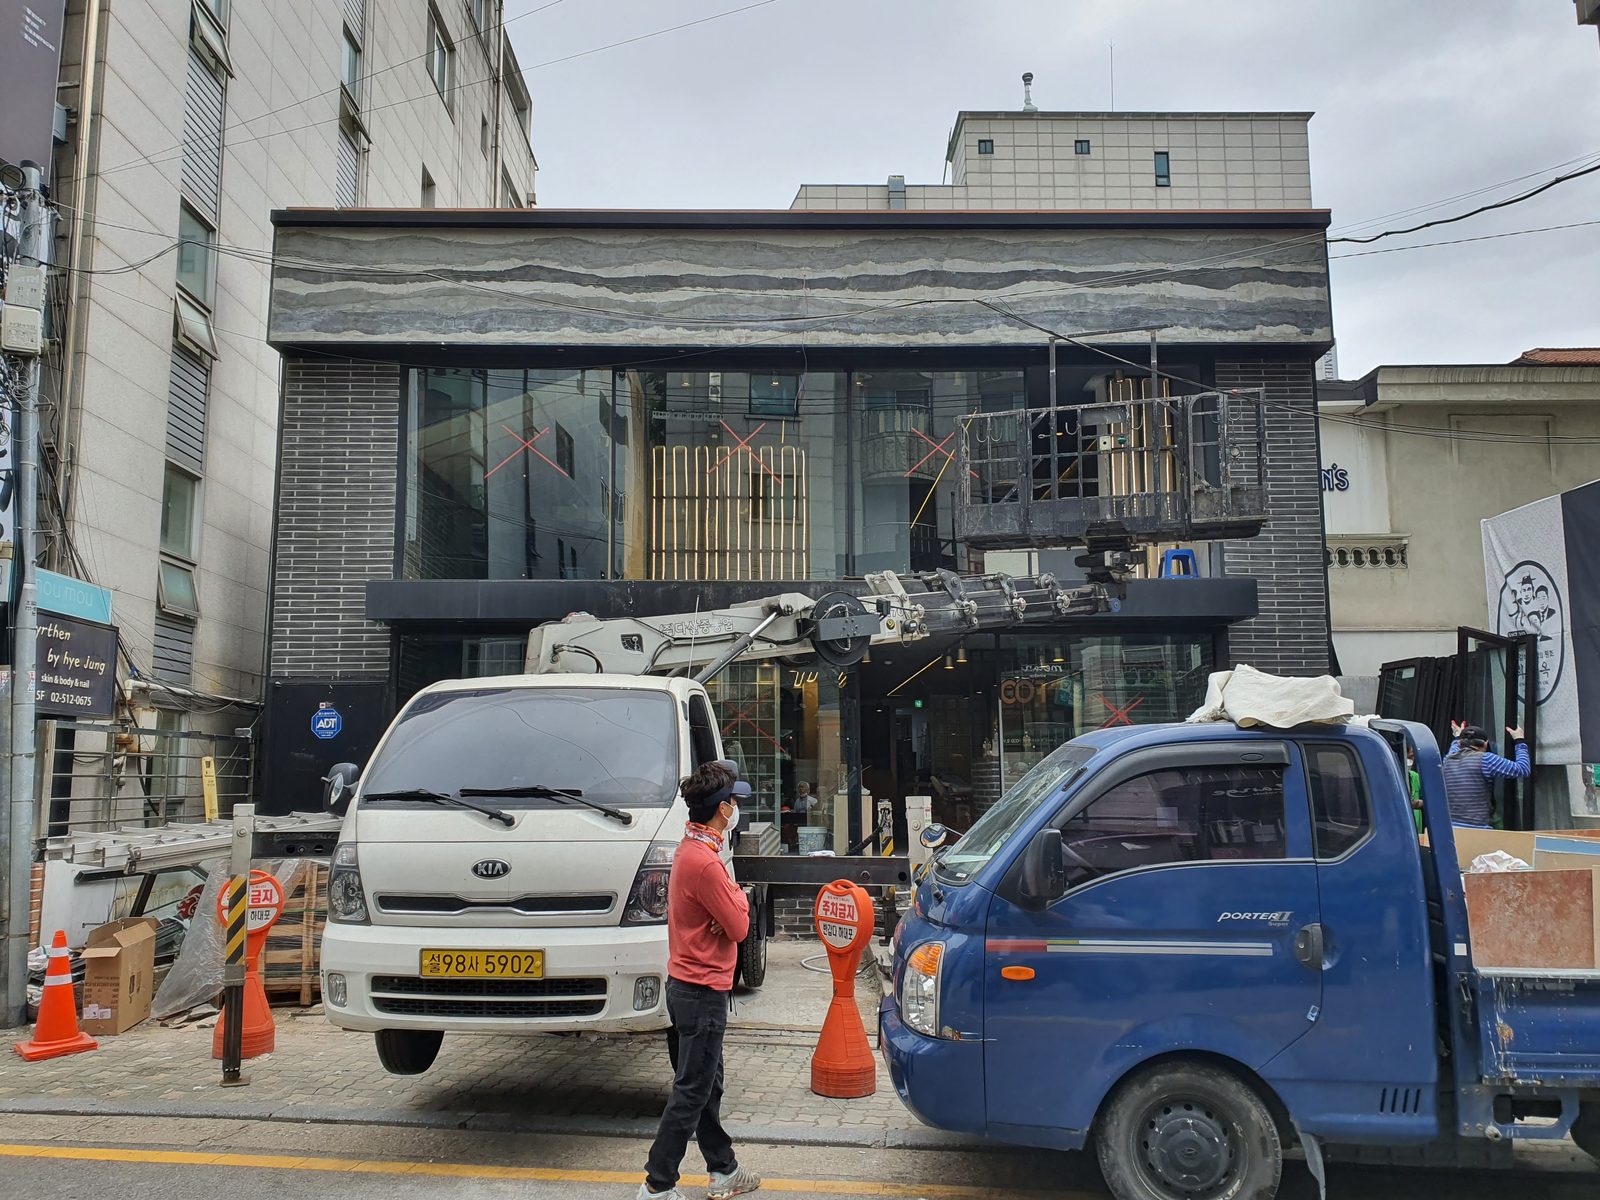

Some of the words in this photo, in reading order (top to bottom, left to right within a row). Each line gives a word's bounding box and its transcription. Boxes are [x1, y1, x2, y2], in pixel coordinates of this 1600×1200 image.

[36, 623, 71, 641] yrthen
[47, 648, 60, 668] by
[63, 651, 80, 668] hye
[41, 673, 54, 683] skin
[59, 676, 74, 688] body
[79, 680, 90, 689] nail
[50, 692, 92, 707] 02-512-0675
[317, 718, 337, 729] ADT
[477, 862, 504, 875] KIA
[250, 889, 273, 904] 금지
[250, 910, 271, 921] 하대포
[822, 900, 855, 921] 주차금지
[485, 954, 535, 974] 5902
